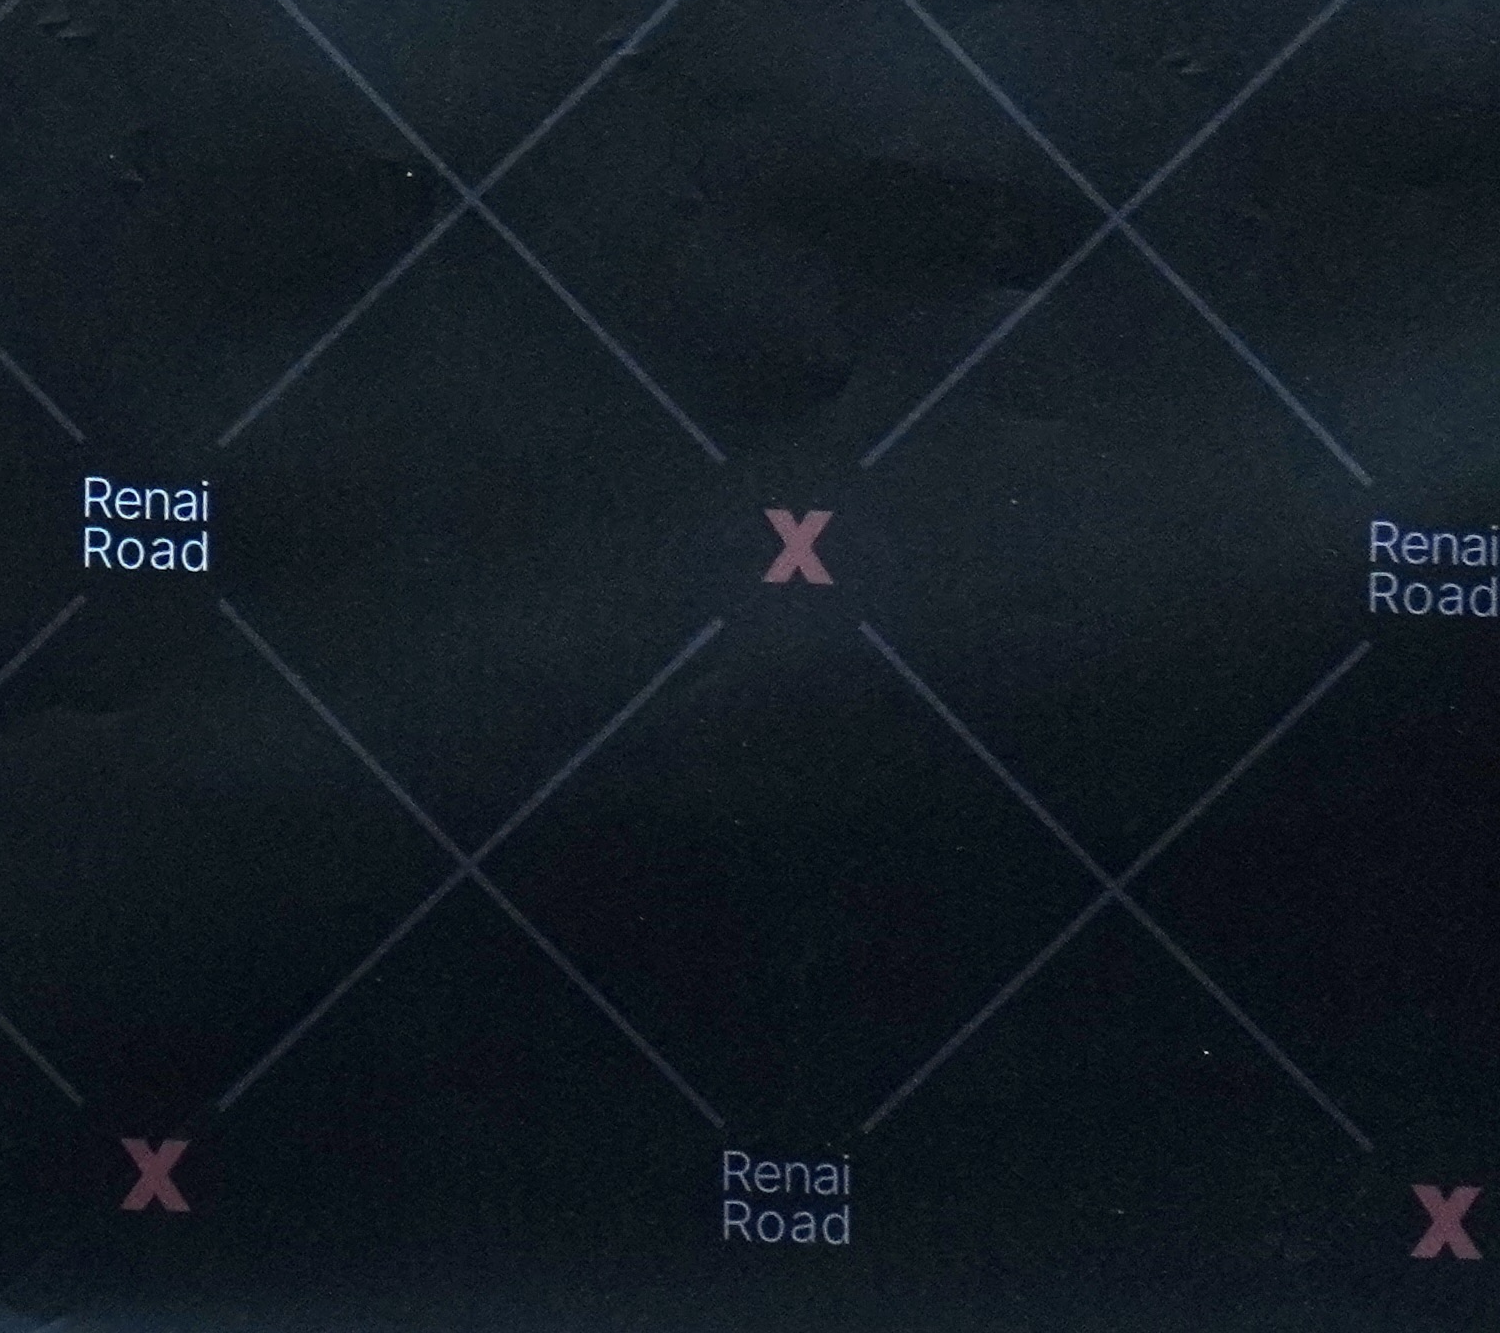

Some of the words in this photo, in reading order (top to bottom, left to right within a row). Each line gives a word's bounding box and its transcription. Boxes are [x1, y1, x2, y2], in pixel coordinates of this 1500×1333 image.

[85, 477, 208, 521] Renai
[84, 526, 208, 571] Road
[1371, 520, 1496, 565] Renai
[1370, 571, 1497, 616] Road
[723, 1150, 849, 1195] Renai
[724, 1199, 849, 1245] Road
